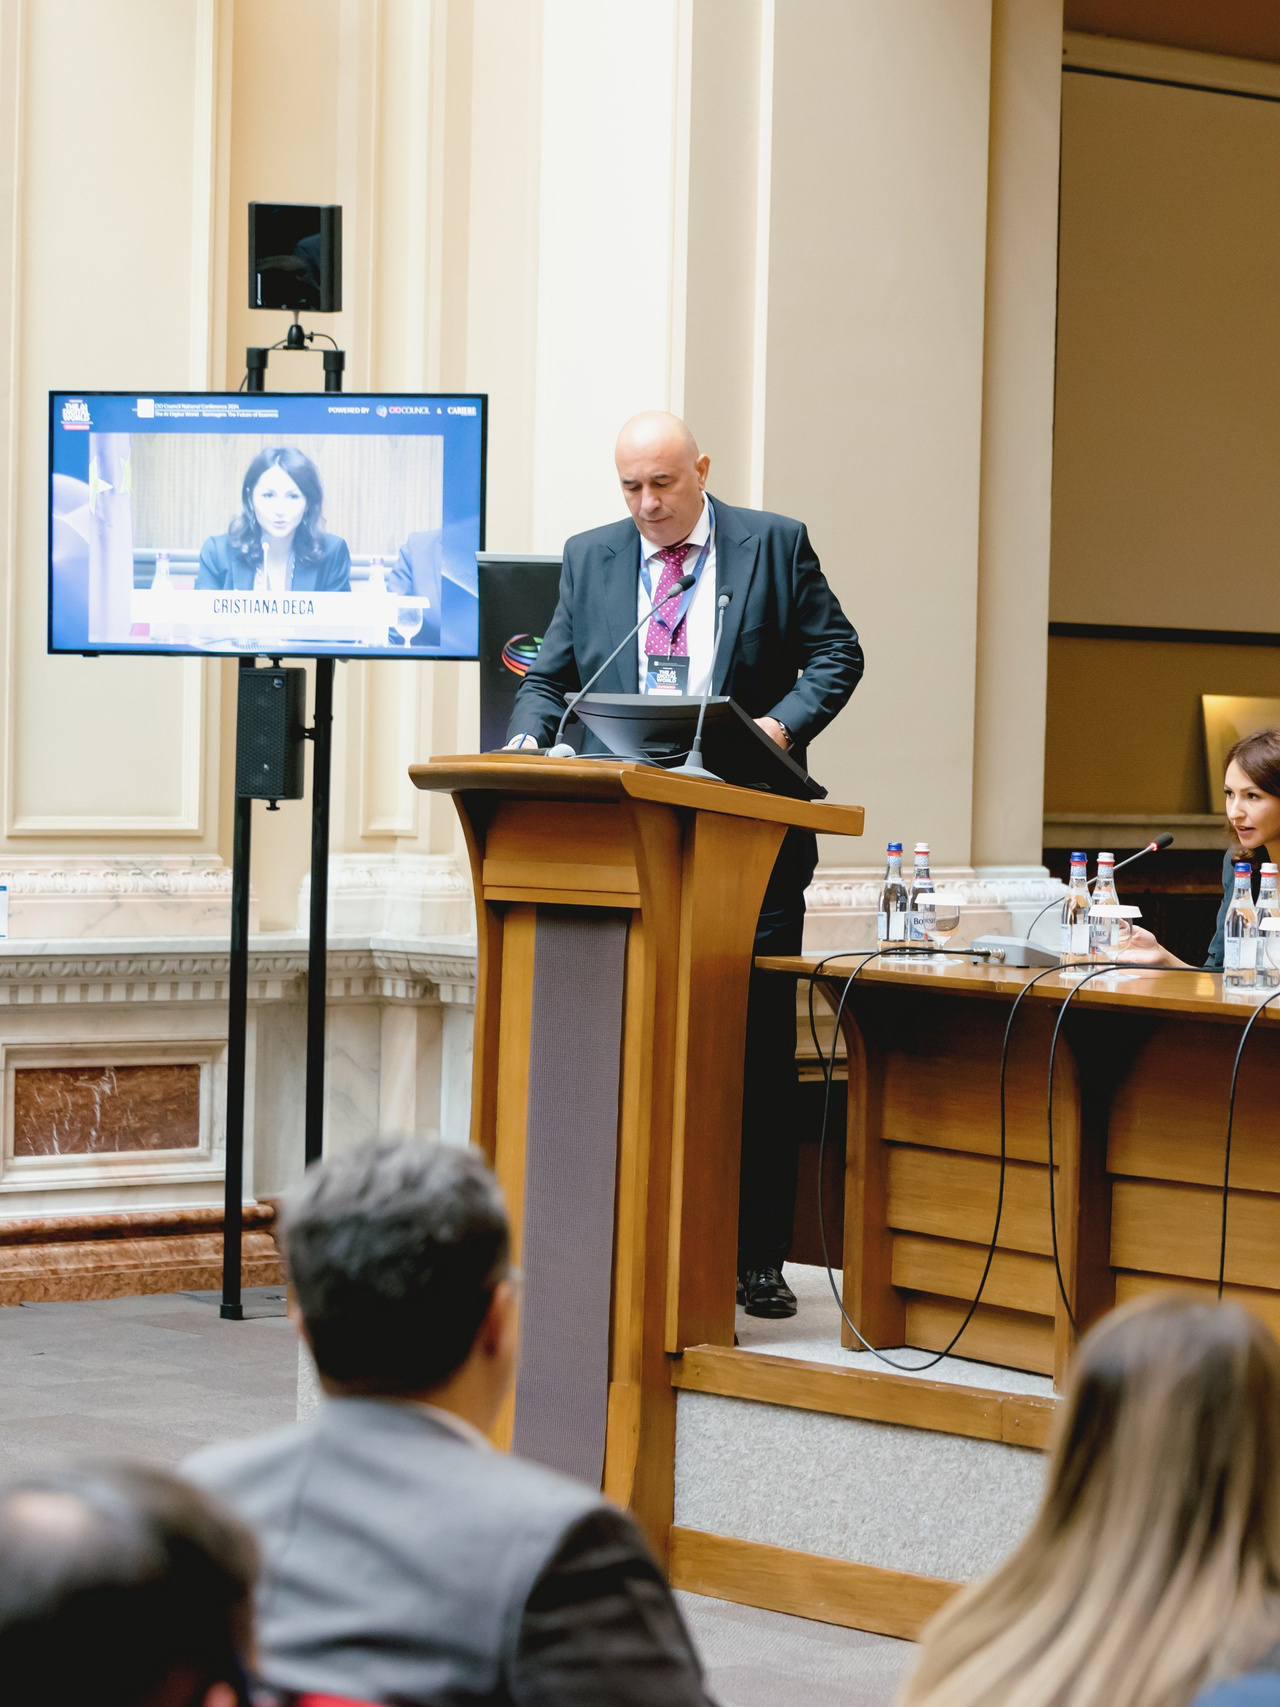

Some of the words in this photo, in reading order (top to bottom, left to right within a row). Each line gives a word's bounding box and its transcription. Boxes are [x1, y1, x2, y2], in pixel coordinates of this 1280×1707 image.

[328, 406, 360, 414] POWERED
[361, 406, 370, 414] BY
[213, 599, 278, 614] CRISTIANA
[282, 600, 314, 615] DECA
